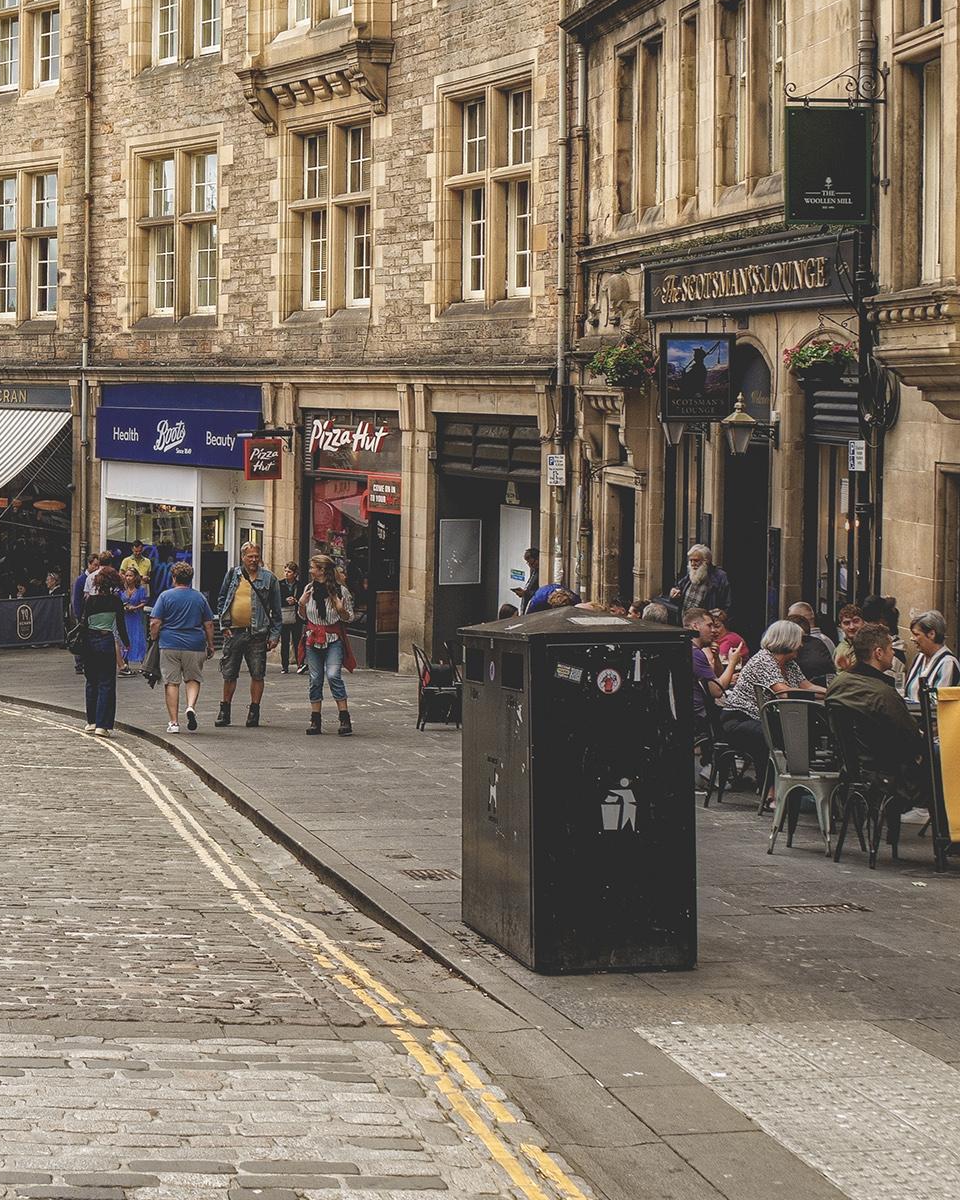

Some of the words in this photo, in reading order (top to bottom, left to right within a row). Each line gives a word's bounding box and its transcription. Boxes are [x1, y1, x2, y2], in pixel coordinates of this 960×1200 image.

[660, 274, 681, 304] The
[681, 263, 762, 302] SCOTSMAN'S
[760, 255, 828, 293] LOUNGE
[671, 399, 724, 408] SCOTSMAN'S
[681, 406, 715, 414] LOUNGE
[112, 427, 139, 442] Health
[153, 419, 186, 452] Boots
[205, 431, 236, 451] Beauty
[308, 418, 352, 453] Pizza
[351, 420, 389, 453] Hut
[249, 447, 279, 460] Pizza
[253, 461, 275, 472] Hut
[373, 484, 384, 492] COME
[385, 485, 390, 493] ON
[370, 494, 375, 502] TO
